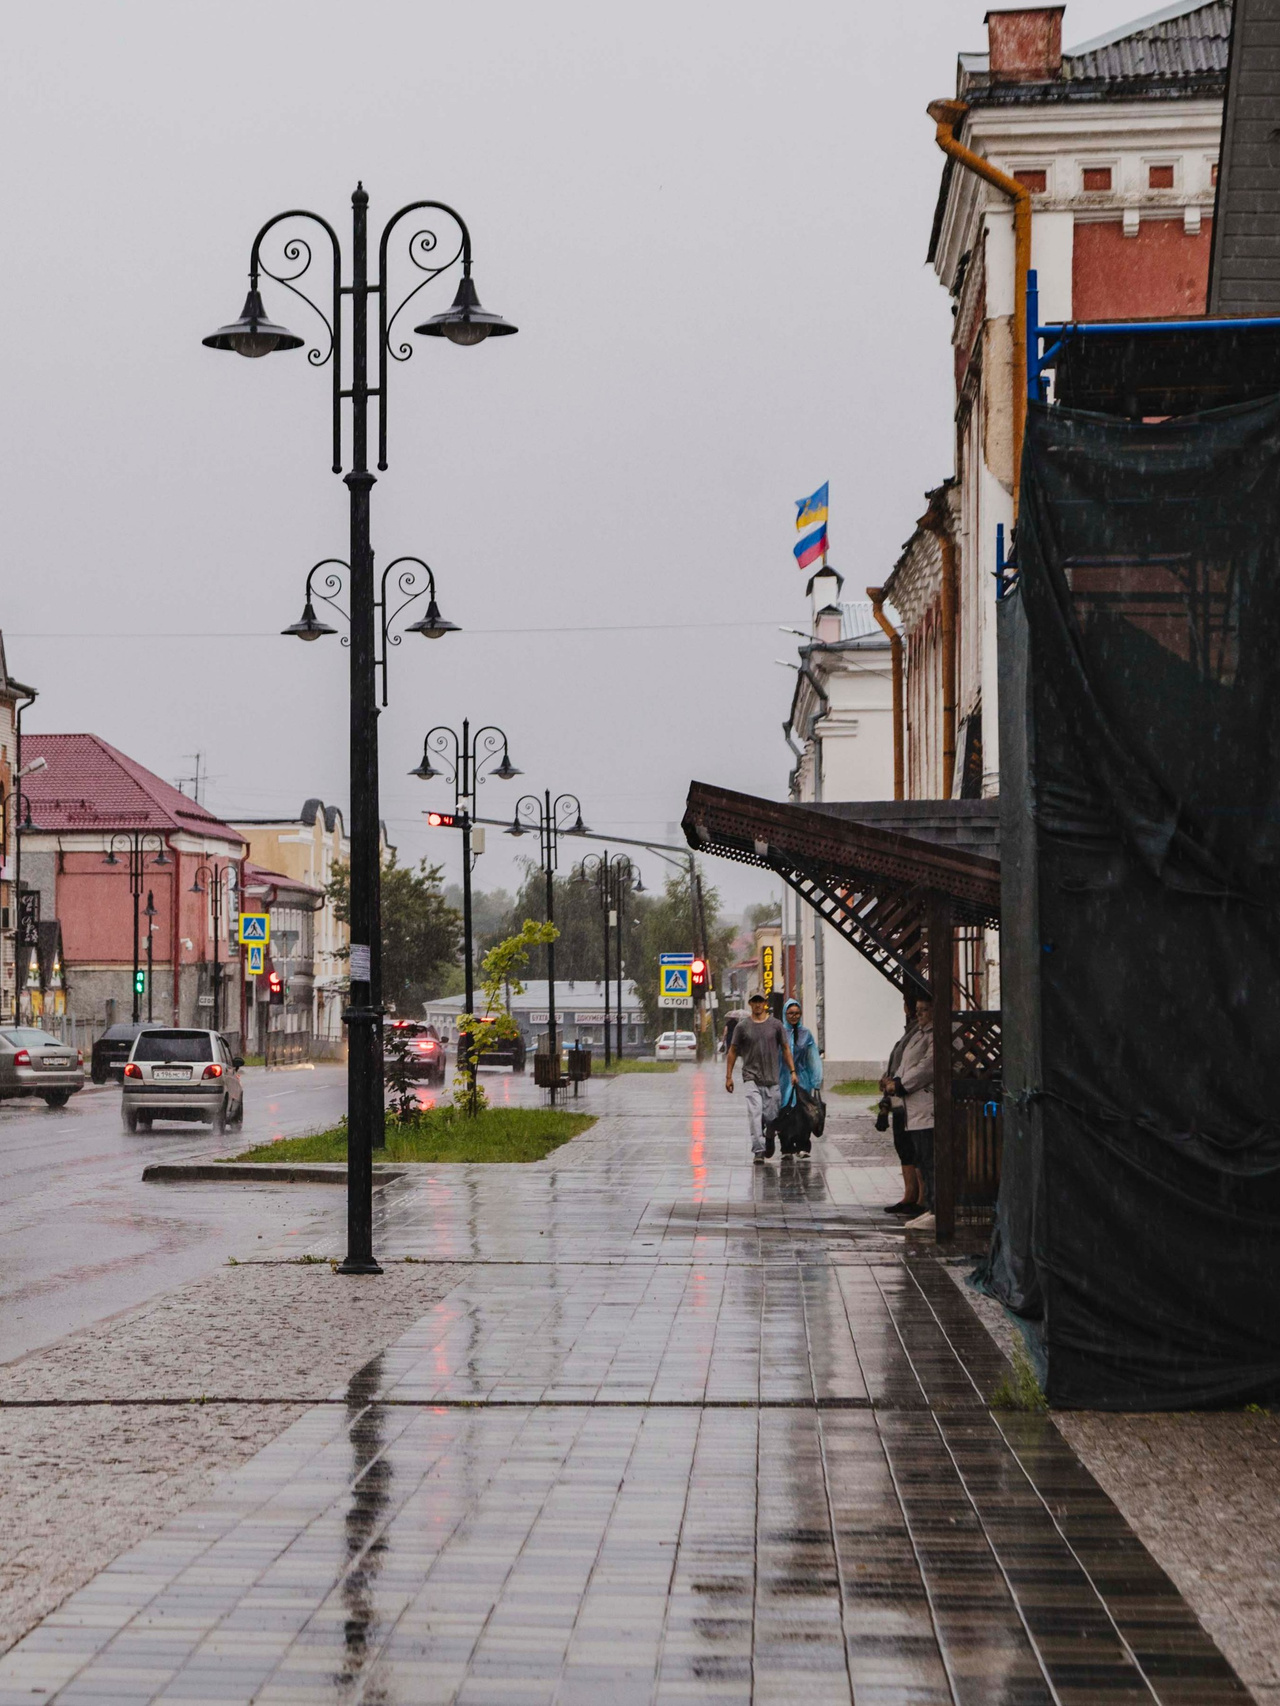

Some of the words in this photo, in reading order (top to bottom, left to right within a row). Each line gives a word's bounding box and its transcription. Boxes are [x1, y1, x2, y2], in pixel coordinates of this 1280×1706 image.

[443, 816, 453, 825] 41
[692, 975, 702, 984] 41
[663, 998, 689, 1006] СТОП
